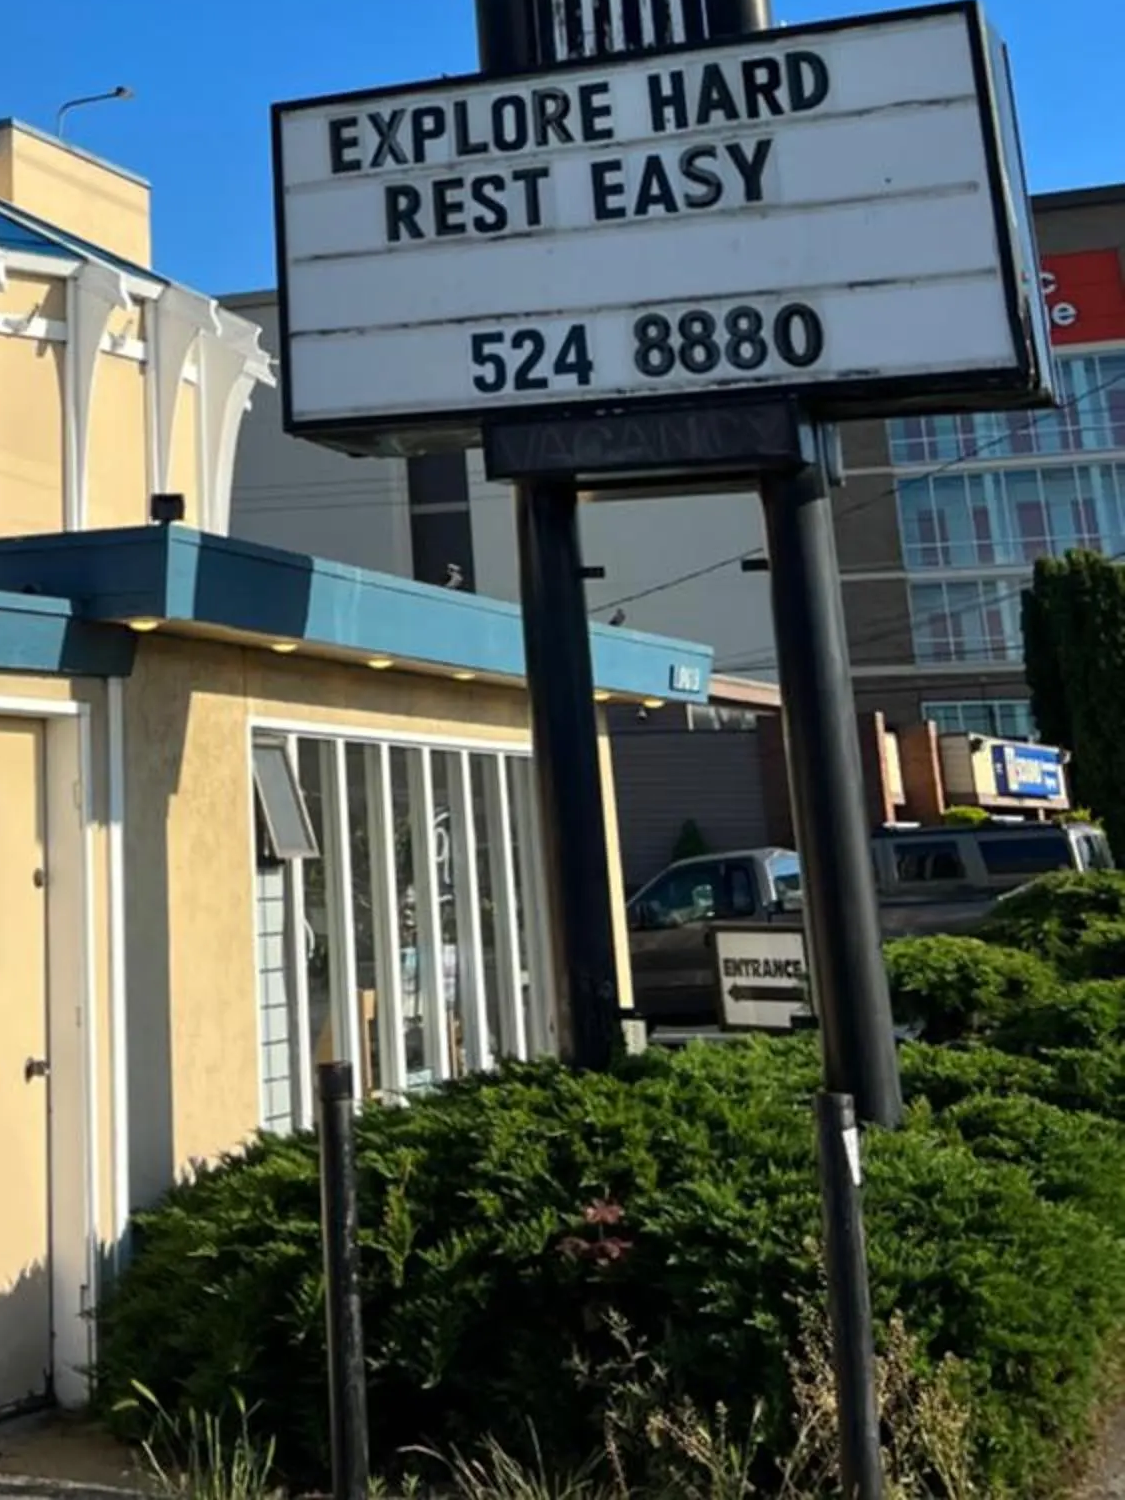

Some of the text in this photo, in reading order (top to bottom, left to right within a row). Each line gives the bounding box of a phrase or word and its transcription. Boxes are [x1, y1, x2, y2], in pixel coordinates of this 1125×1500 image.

[329, 51, 830, 173] EXPLORE HARD
[385, 139, 772, 242] REST EASY
[471, 303, 824, 393] 524 8880
[723, 958, 802, 978] ENTRANCE
